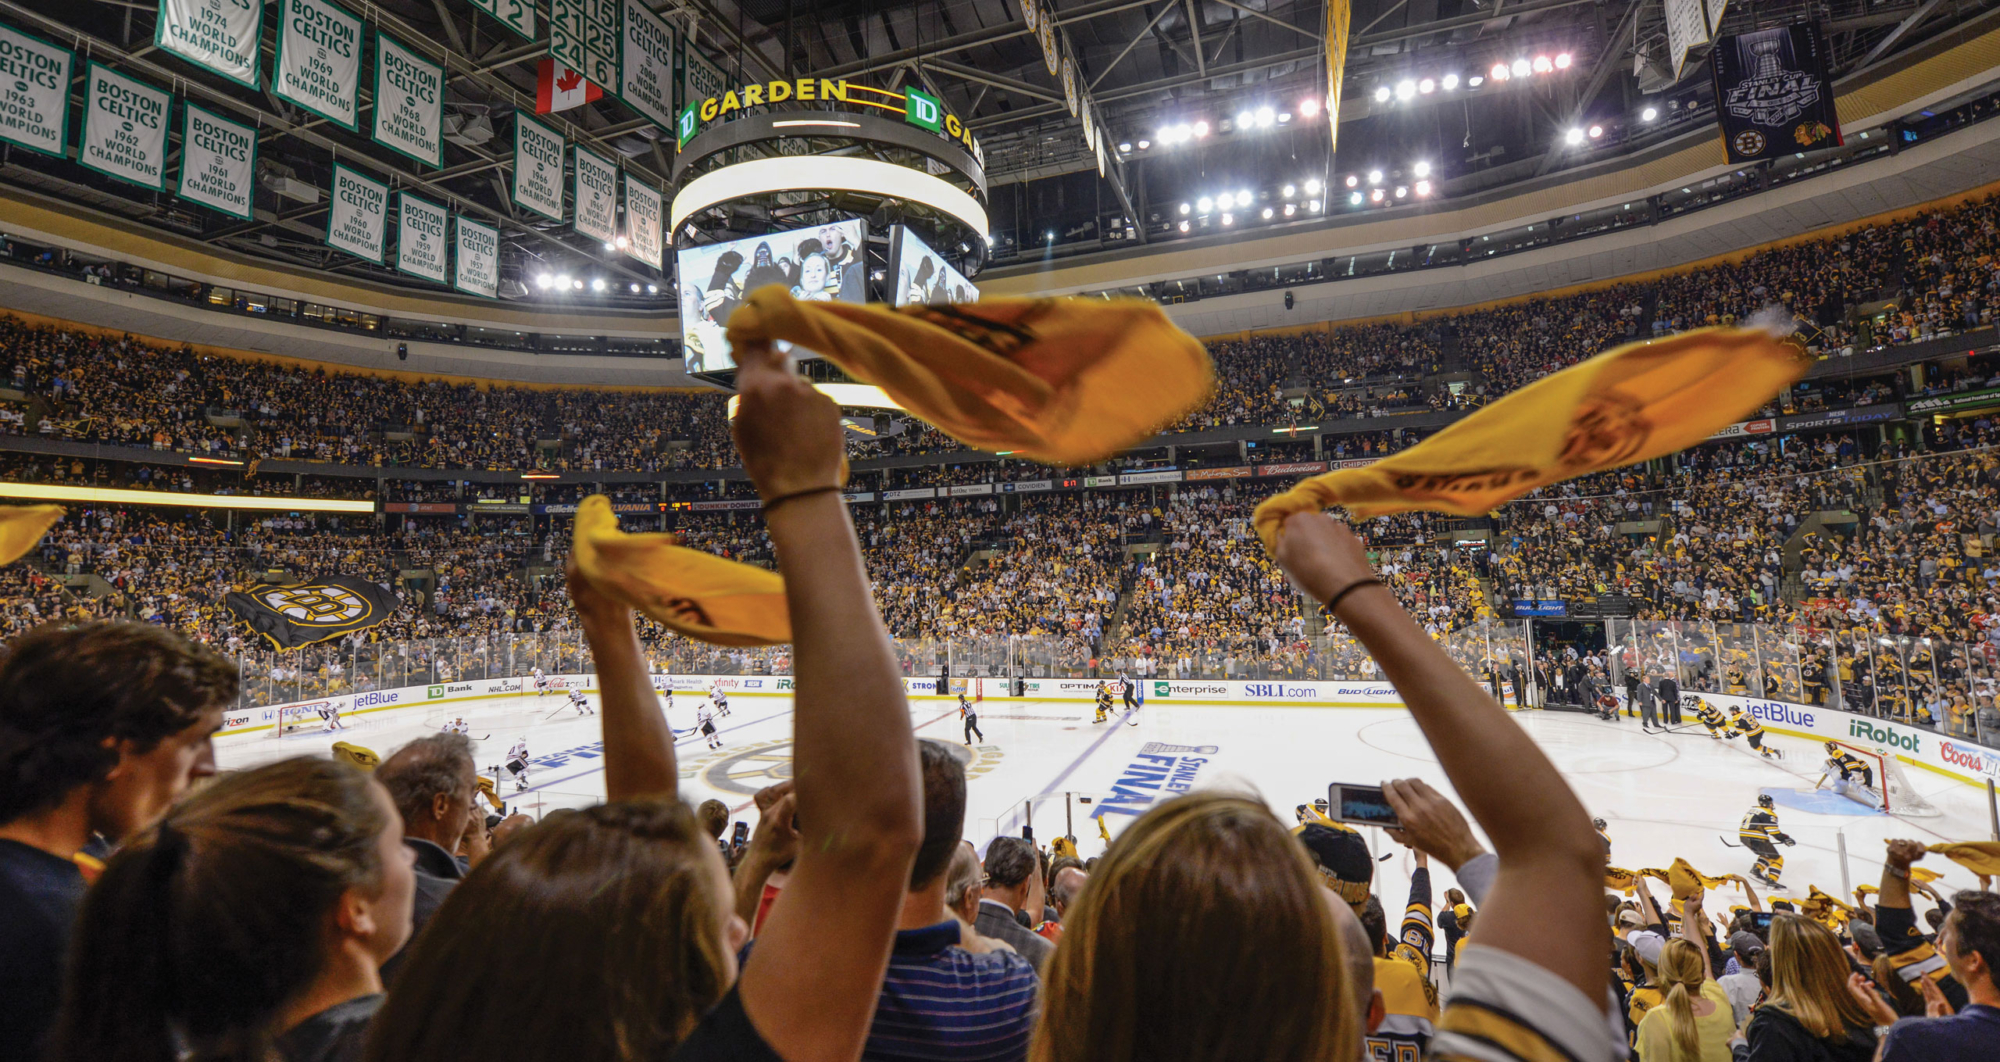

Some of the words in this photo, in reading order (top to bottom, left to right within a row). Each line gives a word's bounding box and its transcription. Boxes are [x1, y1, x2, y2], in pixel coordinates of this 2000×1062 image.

[200, 7, 227, 29] 1974
[292, 0, 354, 43] BOSTON
[555, 4, 580, 36] 21
[628, 4, 670, 50] BOSTON
[189, 16, 236, 48] WORLD
[293, 18, 350, 58] CELTICS
[0, 40, 61, 75] OSTON
[170, 24, 250, 68] CHAMPIONS
[553, 30, 582, 69] 24
[588, 24, 614, 59] 25
[630, 28, 668, 66] CELTICS
[0, 56, 56, 90] ELTICS
[308, 56, 332, 76] 1969
[385, 51, 436, 90] BOSTON
[595, 61, 607, 84] 6
[640, 64, 656, 84] 2008
[688, 54, 723, 92] BOSTON
[300, 65, 339, 93] WORLD
[387, 70, 434, 104] CELTICS
[636, 75, 661, 100] WORLD
[1729, 76, 1820, 103] FINAL
[1741, 76, 1781, 89] STANLEY
[1782, 72, 1802, 82] CUP
[6, 89, 35, 108] 1963
[98, 79, 161, 116] BOSTON
[286, 72, 350, 112] CHAMPIONS
[628, 82, 668, 118] CHAMPIONS
[99, 97, 158, 129] CELTICS
[400, 104, 420, 122] 1968
[0, 114, 56, 140] AMPIONS
[193, 118, 248, 149] BOSTON
[382, 120, 436, 153] CHAMPIONS
[393, 113, 426, 137] WORLD
[680, 110, 694, 138] TD
[700, 78, 848, 121] GARDEN
[911, 94, 938, 124] TD
[946, 114, 985, 172] GARD
[105, 138, 146, 160] WORLD
[114, 130, 139, 146] 1962
[194, 134, 245, 162] CELTICS
[522, 126, 560, 156] BOSTON
[90, 146, 157, 176] CHAMPIONS
[522, 141, 558, 168] CELTICS
[200, 172, 235, 192] WORLD
[208, 164, 228, 178] 1961
[532, 170, 548, 184] 1966
[580, 158, 612, 186] BOSTON
[188, 179, 245, 206] CHAMPIONS
[339, 176, 382, 204] BOSTON
[528, 178, 552, 197] WORLD
[581, 173, 612, 196] CELTICS
[340, 190, 379, 215] CELTICS
[519, 185, 560, 210] CHAMPIONS
[629, 187, 658, 211] BOSTON
[350, 216, 367, 229] 1960
[405, 204, 442, 226] BOSTON
[586, 207, 607, 223] WORLD
[630, 201, 657, 222] CELTICS
[344, 223, 371, 240] WORLD
[407, 217, 441, 237] CELTICS
[461, 226, 494, 246] BOSTON
[579, 214, 614, 236] CHAMPIONS
[334, 229, 379, 253] CHAMPIONS
[416, 241, 430, 251] 1959
[463, 238, 492, 256] CELTICS
[630, 238, 659, 259] HAMPIONS
[636, 232, 653, 247] WORLD
[403, 254, 442, 272] CHAMPIONS
[412, 248, 435, 262] WORLD
[471, 260, 483, 269] 1957
[460, 274, 494, 290] CHAMPIONS
[467, 268, 488, 280] WORLD
[1786, 418, 1842, 429] SPORTS
[1843, 412, 1892, 422] TODAY
[1264, 464, 1321, 475] Budweiser
[610, 504, 650, 512] LVANIA
[430, 687, 442, 696] TD
[488, 685, 521, 693] NHL.COM
[714, 678, 739, 688] xfinity
[1160, 685, 1226, 695] enterprise
[1245, 684, 1316, 697] SBLI.com
[353, 692, 398, 710] jetBlue
[224, 716, 249, 727] rizon
[1747, 700, 1814, 727] jetBlue
[1850, 719, 1920, 753] iRobot
[1940, 741, 1982, 772] Coors
[1089, 754, 1178, 820] FINAL
[1165, 756, 1208, 795] STANLEY
